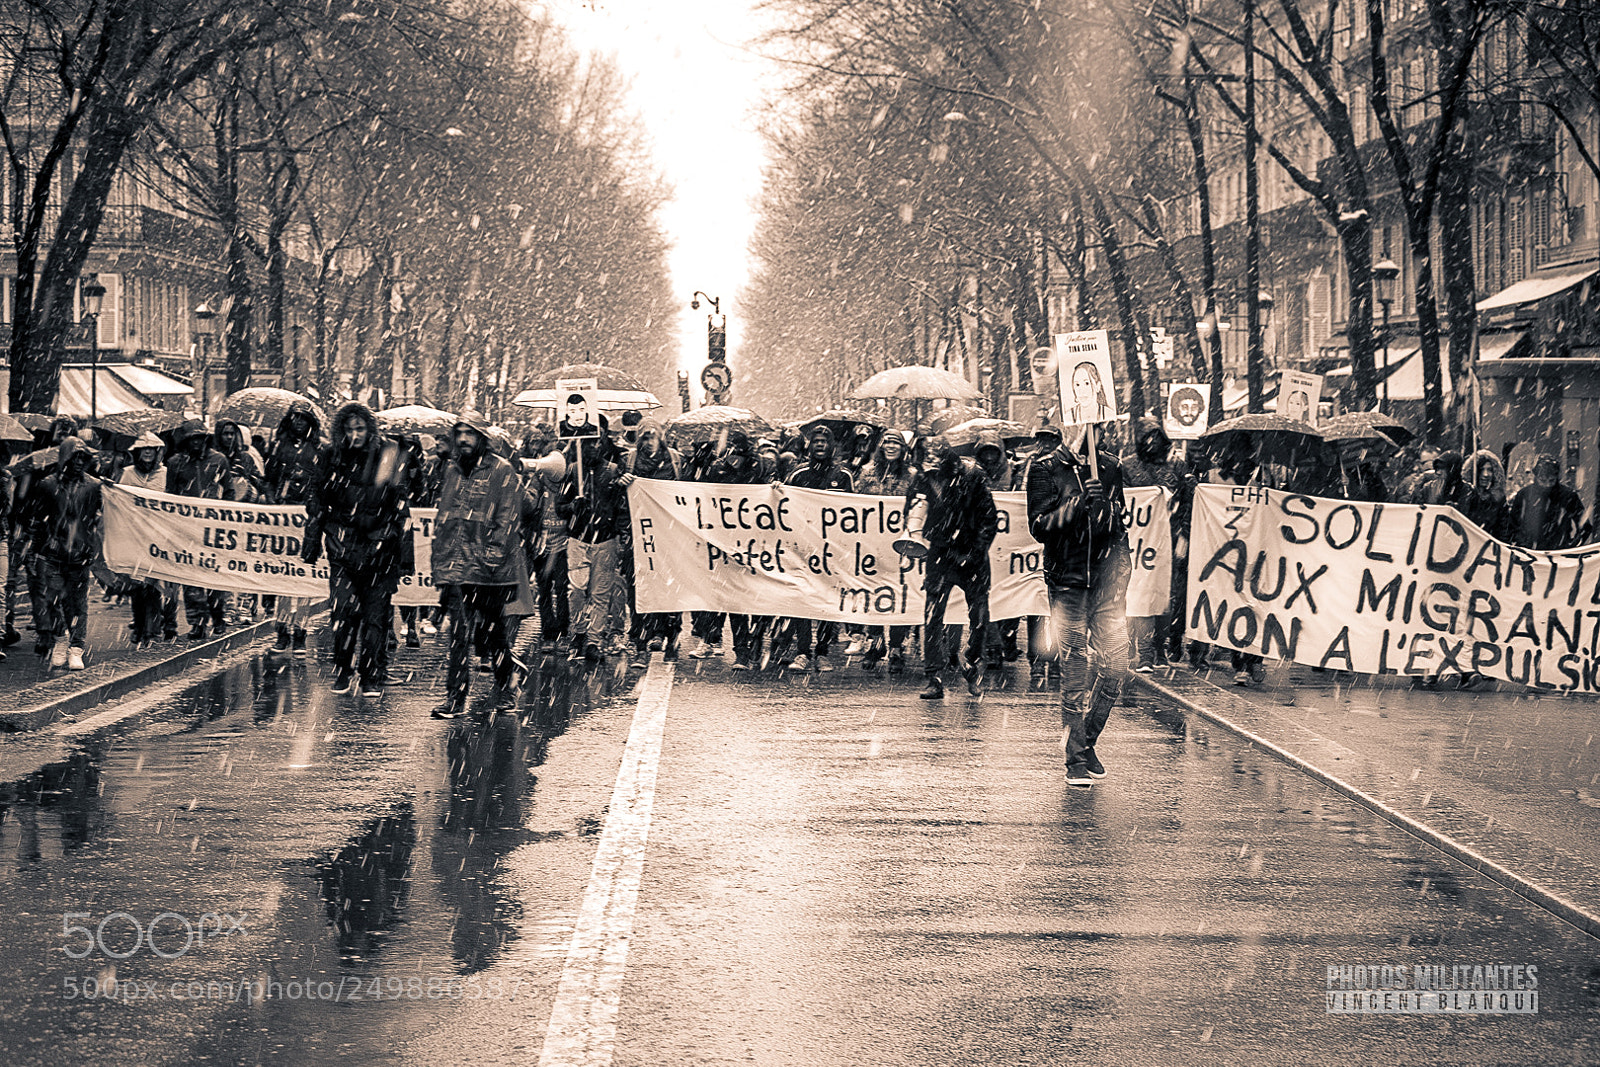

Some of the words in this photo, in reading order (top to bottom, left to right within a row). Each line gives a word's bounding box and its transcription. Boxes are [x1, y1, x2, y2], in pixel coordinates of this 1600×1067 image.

[203, 527, 239, 550] LES
[822, 501, 901, 539] parle
[150, 543, 169, 559] On
[174, 550, 194, 565] vit
[199, 552, 221, 573] ici,
[227, 559, 248, 572] on
[808, 542, 833, 576] et
[855, 541, 877, 576] le
[1131, 538, 1157, 571] le
[1199, 539, 1327, 614] AUX
[839, 583, 908, 614] mal
[1190, 590, 1301, 660] NON
[1320, 626, 1353, 671] A
